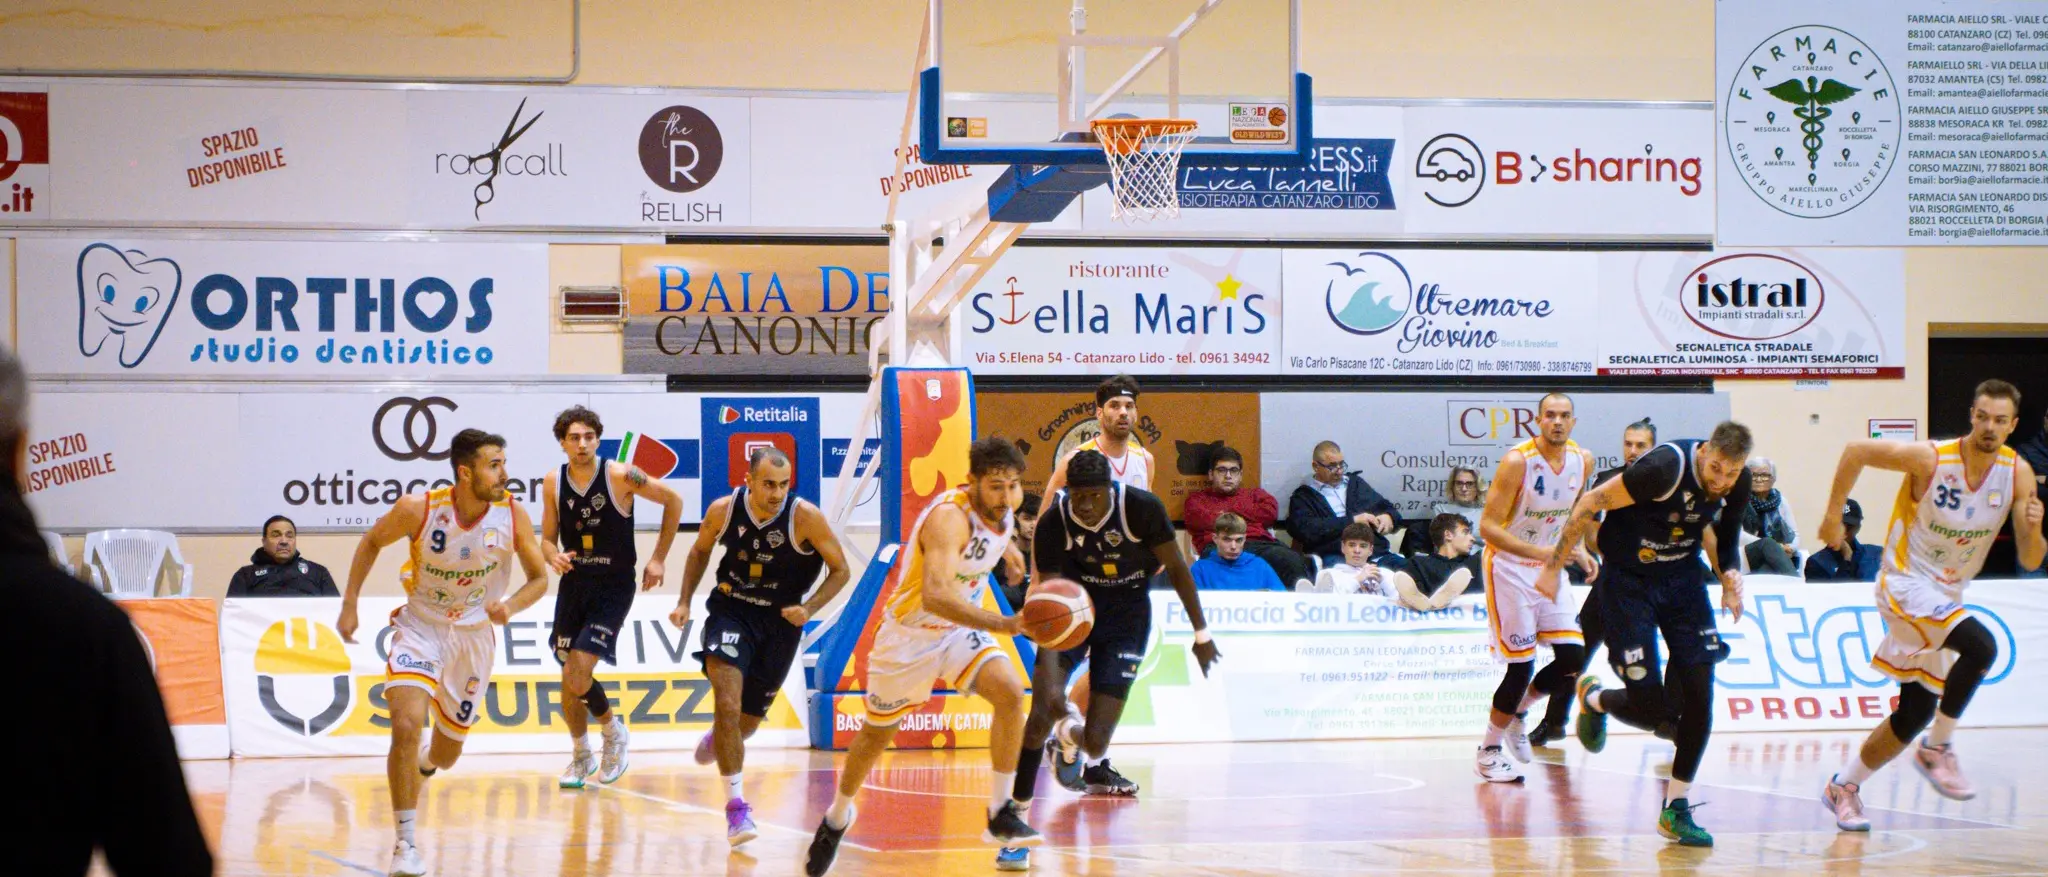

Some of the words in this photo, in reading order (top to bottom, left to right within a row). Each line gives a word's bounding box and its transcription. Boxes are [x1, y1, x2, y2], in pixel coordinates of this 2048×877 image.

[1907, 15, 1955, 24] FARMACIA
[1957, 15, 1989, 24] AIELLO
[1991, 15, 2007, 24] SRL
[2014, 15, 2040, 24] VIALE
[1907, 30, 1936, 39] 88100
[1937, 30, 1992, 39] CATANZARO
[1994, 30, 2012, 39] (CZ)
[2015, 30, 2031, 39] Tel.
[1907, 42, 1935, 52] Email:
[1739, 35, 1889, 101] FARMACIE
[1907, 61, 1965, 70] FARMAIELLO
[1967, 61, 1983, 70] SRL
[1991, 61, 2007, 70] VIA
[2009, 61, 2037, 70] DELLA
[1907, 75, 1936, 84] 87032
[1937, 75, 1985, 84] AMANTEA
[1986, 75, 2005, 84] (CS)
[2007, 75, 2023, 84] Tel.
[1907, 88, 1935, 98] Email:
[1907, 106, 1956, 115] FARMACIA
[1958, 106, 1989, 115] AIELLO
[1991, 106, 2035, 115] GIUSEPPE
[658, 111, 693, 148] the
[1907, 119, 1936, 128] 88838
[1938, 119, 1990, 128] MESORACA
[1992, 119, 2005, 128] KR
[2008, 119, 2024, 128] Tel.
[201, 127, 259, 158] SPAZIO
[1907, 132, 1936, 142] Email:
[669, 139, 700, 184] R
[1908, 150, 1957, 159] FARMACIA
[1958, 150, 1977, 159] SAN
[1980, 150, 2030, 159] LEONARDO
[186, 147, 286, 188] DISPONIBILE
[1736, 142, 1776, 196] GRUPPO
[1780, 193, 1834, 209] AIELLO
[1839, 142, 1891, 202] GIUSEPPE
[1908, 163, 1940, 173] CORSO
[1942, 163, 1985, 173] MAZZINI,
[1986, 163, 1998, 173] 77
[1999, 163, 2026, 173] 88021
[1183, 170, 1256, 191] Luca
[1908, 175, 1936, 185] Email:
[1178, 194, 1257, 209] FISIOTERAPIA
[1262, 194, 1344, 209] CATANZARO
[1348, 194, 1379, 209] LIDO
[1908, 193, 1957, 202] FARMACIA
[1959, 193, 1978, 202] SAN
[1981, 193, 2031, 202] LEONARDO
[642, 202, 722, 223] RELISH
[1909, 204, 1925, 214] VIA
[1927, 204, 2001, 214] RISORGIMENTO,
[2003, 204, 2015, 214] 46
[1909, 216, 1936, 225] 88021
[1938, 216, 1994, 225] ROCCELLETA
[1996, 216, 2007, 225] DI
[2008, 216, 2045, 225] BORGIA
[1909, 228, 1937, 238] Email:
[1069, 261, 1170, 279] ristorante
[654, 265, 795, 313] BAIA
[1697, 272, 1807, 308] istral
[190, 272, 494, 334] ORTHOS
[1698, 310, 1742, 321] Impianti
[1744, 310, 1785, 320] stradali
[1787, 310, 1807, 320] s.r.l.
[1397, 314, 1501, 354] Giovino
[190, 337, 299, 364] studio
[315, 337, 494, 365] dentistico
[1501, 339, 1515, 348] Bed
[1524, 340, 1559, 349] Breakfast
[1675, 343, 1752, 352] SEGNALETICA
[1754, 343, 1814, 352] STRADALE
[976, 352, 995, 364] Via
[999, 352, 1044, 364] S.Elena
[1048, 352, 1063, 364] 54
[1074, 352, 1136, 364] Catanzaro
[1140, 352, 1166, 364] Lido
[1176, 352, 1196, 364] tel.
[1200, 352, 1229, 365] 0961
[1233, 352, 1271, 364] 34942
[1290, 356, 1304, 368] Via
[1306, 357, 1328, 369] Carlo
[1330, 357, 1368, 370] Pisacane
[1369, 358, 1385, 370] 12C
[1392, 359, 1433, 371] Catanzaro
[1436, 359, 1454, 371] Lido
[1456, 360, 1474, 373] (CZ)
[1477, 360, 1495, 372] Info:
[1496, 361, 1542, 373] 0961/730980
[1547, 361, 1593, 373] 338/8746799
[1608, 355, 1687, 365] SEGNALETICA
[1688, 355, 1747, 364] LUMINOSA
[1757, 354, 1809, 364] IMPIANTI
[1811, 354, 1880, 364] SEMAFORICI
[1608, 368, 1628, 376] VIALE
[1629, 368, 1657, 376] EUROPA
[1661, 368, 1679, 376] ZONA
[1680, 368, 1724, 376] INDUSTRIALE,
[1726, 368, 1739, 376] SNC
[1763, 368, 1804, 376] CATANZARO
[1808, 368, 1820, 376] TEL
[1826, 368, 1839, 376] FAX
[744, 406, 809, 423] Retitalia
[1459, 407, 1539, 440] CPR
[28, 433, 88, 465] SPAZIO
[1380, 450, 1489, 471] Consulenza
[20, 452, 116, 495] ISPONIBILE
[1533, 475, 1546, 497] 4
[1934, 484, 1962, 511] 35
[430, 529, 448, 554] 9
[964, 536, 991, 561] 36
[1294, 601, 1340, 624] San
[1294, 646, 1350, 656] FARMACIA
[1352, 646, 1375, 656] SAN
[1378, 646, 1437, 656] LEONARDO
[1321, 671, 1389, 682] 0961.951122
[1397, 671, 1430, 682] Email:
[456, 700, 474, 722] 9
[899, 713, 952, 732] CADEMY
